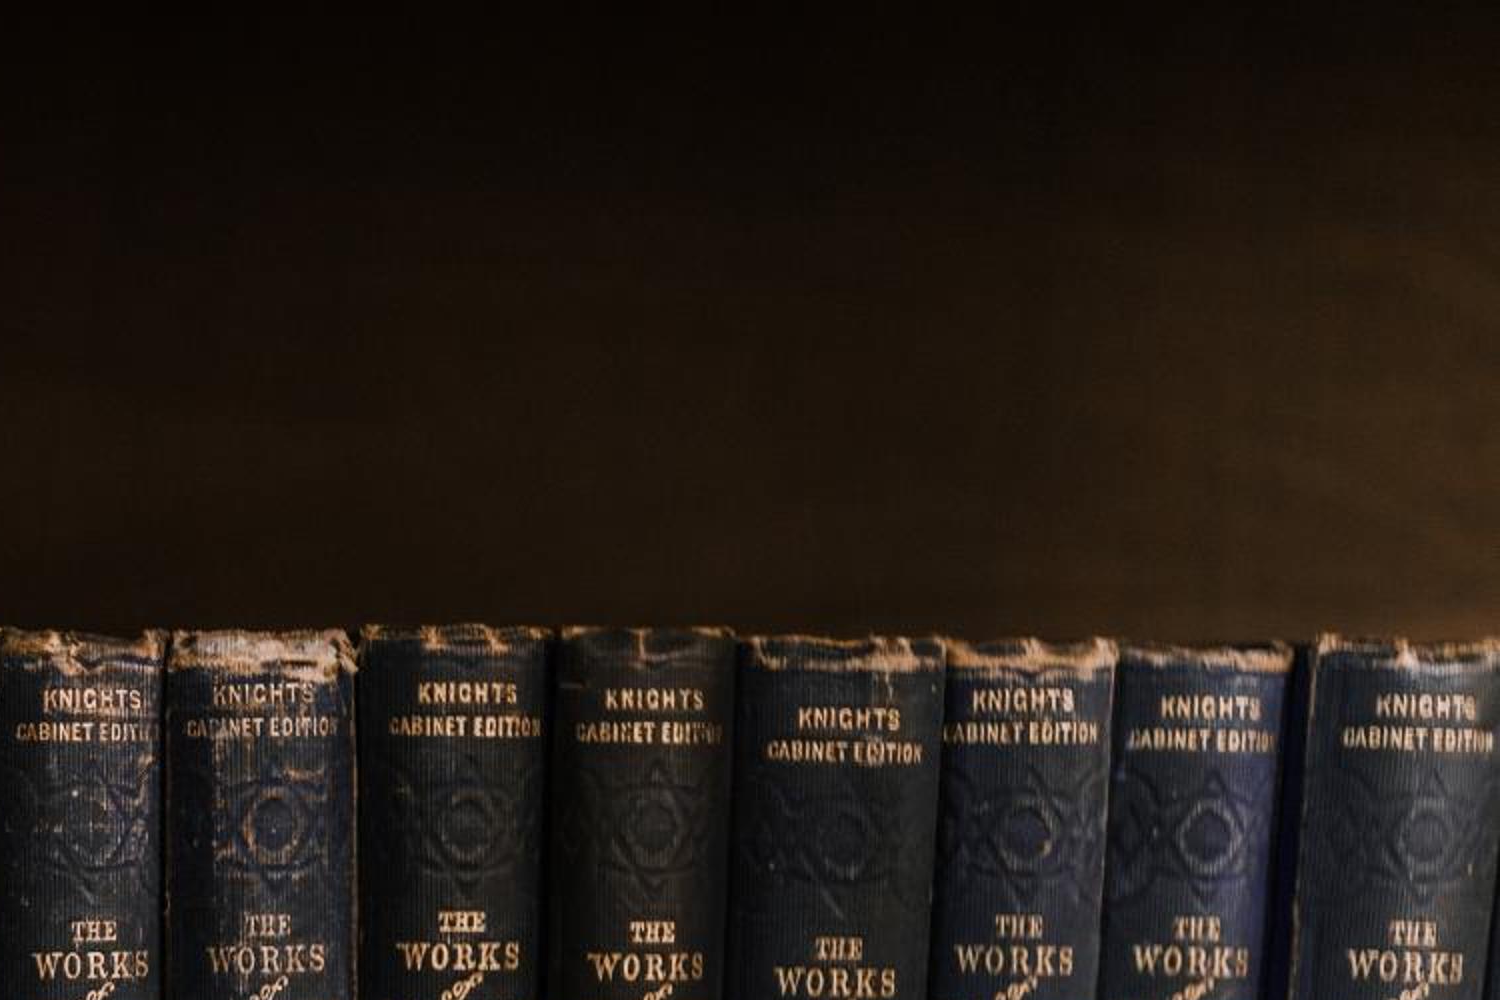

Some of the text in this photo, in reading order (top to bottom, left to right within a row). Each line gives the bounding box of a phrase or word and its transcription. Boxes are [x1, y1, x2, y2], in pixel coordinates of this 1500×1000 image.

[43, 688, 141, 711] KNIGHTS
[212, 682, 315, 704] KNIGHTS
[418, 681, 517, 703] KNIGHTS
[604, 687, 705, 711] KNIGHTS
[973, 688, 1074, 713] KNIGHTS
[799, 706, 900, 731] KNIGHTS
[1160, 695, 1261, 720] KNIGHTS
[1376, 692, 1476, 720] KNIGHTS
[15, 721, 94, 743] CABINET
[389, 714, 542, 738] CABINET EDITION
[575, 720, 655, 744] CABINET
[1029, 720, 1097, 745] EDITION
[1343, 725, 1428, 751] CABINET
[766, 739, 848, 763] CABINET
[71, 920, 117, 943] THE
[244, 913, 291, 936] THE
[438, 911, 486, 933] THE
[630, 920, 676, 943] THE
[995, 914, 1043, 940] THE
[1173, 915, 1221, 943] THE
[1388, 920, 1437, 947] THE
[207, 944, 326, 974] WORKS
[397, 942, 520, 971] WORKS
[815, 937, 863, 961] THE
[953, 944, 1074, 976] WORKS
[32, 951, 149, 982] WORKS
[588, 953, 704, 982] WORKS
[1133, 945, 1250, 979] WORKS
[1348, 949, 1463, 985] WORKS
[774, 966, 896, 998] WORKS
